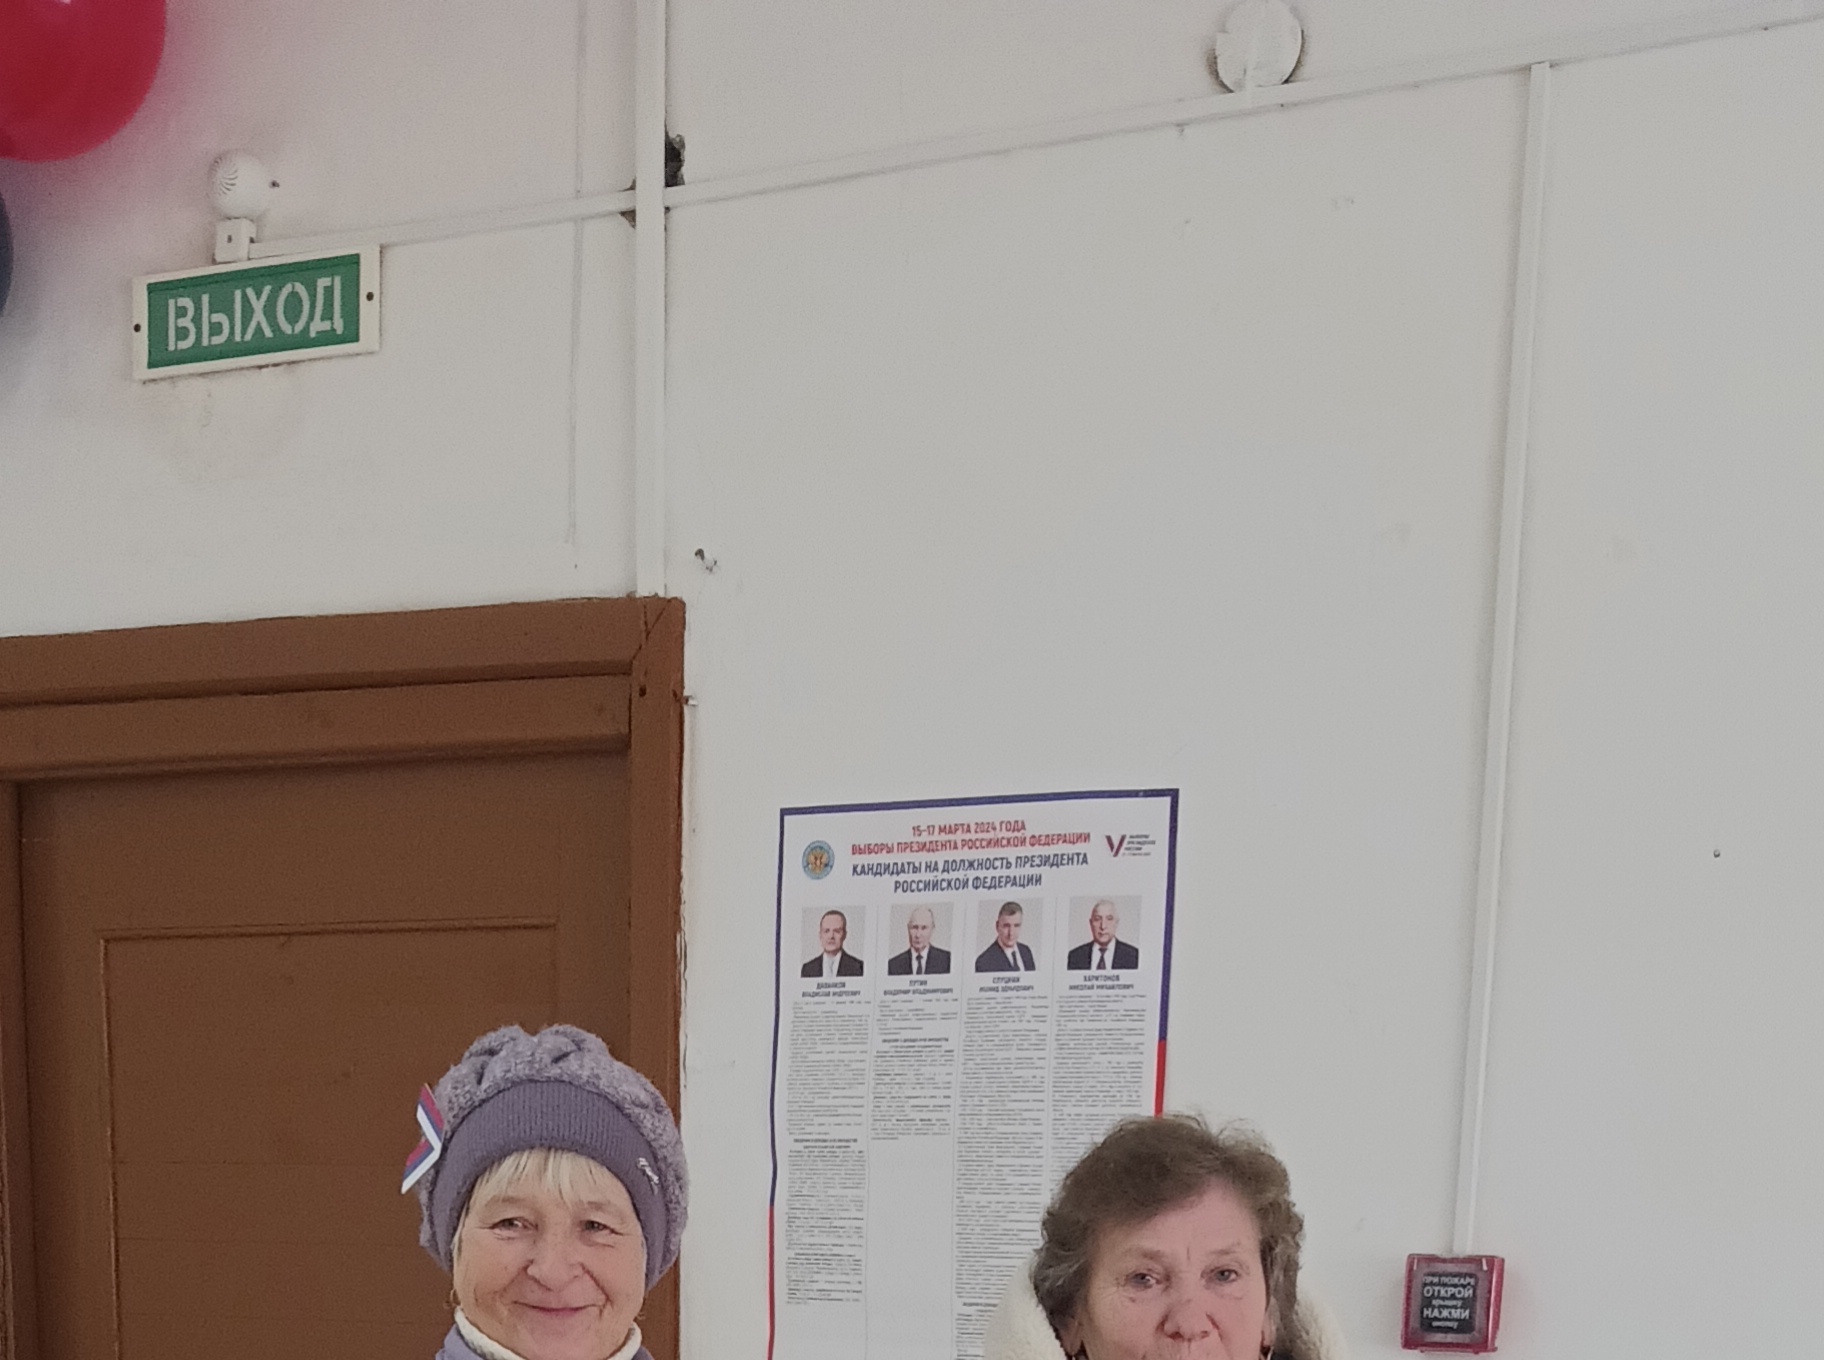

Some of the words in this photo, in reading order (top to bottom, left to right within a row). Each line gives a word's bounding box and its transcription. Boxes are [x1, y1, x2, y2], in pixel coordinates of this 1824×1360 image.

[168, 275, 344, 351] ВЫХОД
[938, 822, 972, 836] МАРТА
[974, 821, 997, 834] 2024
[999, 820, 1026, 833] ГОДА
[851, 842, 895, 856] ВЫБОРЫ
[897, 839, 959, 853] ПРЕЗИДЕНТА
[961, 834, 1027, 850] РОССИЙСКОЙ
[1029, 832, 1091, 847] ФЕДЕРАЦИИ
[852, 862, 922, 877] КАНДИДАТЫ
[924, 860, 939, 874] НА
[941, 856, 1013, 873] ДОЛЖНОСТЬ
[1015, 852, 1089, 869] ПРЕЗИДЕНТА
[893, 873, 969, 893] РОССИЙСКОЙ
[971, 873, 1042, 890] ФЕДЕРАЦИИ
[1423, 1286, 1474, 1298] ОТКРОЙ
[1423, 1307, 1470, 1319] НАЖМИ
